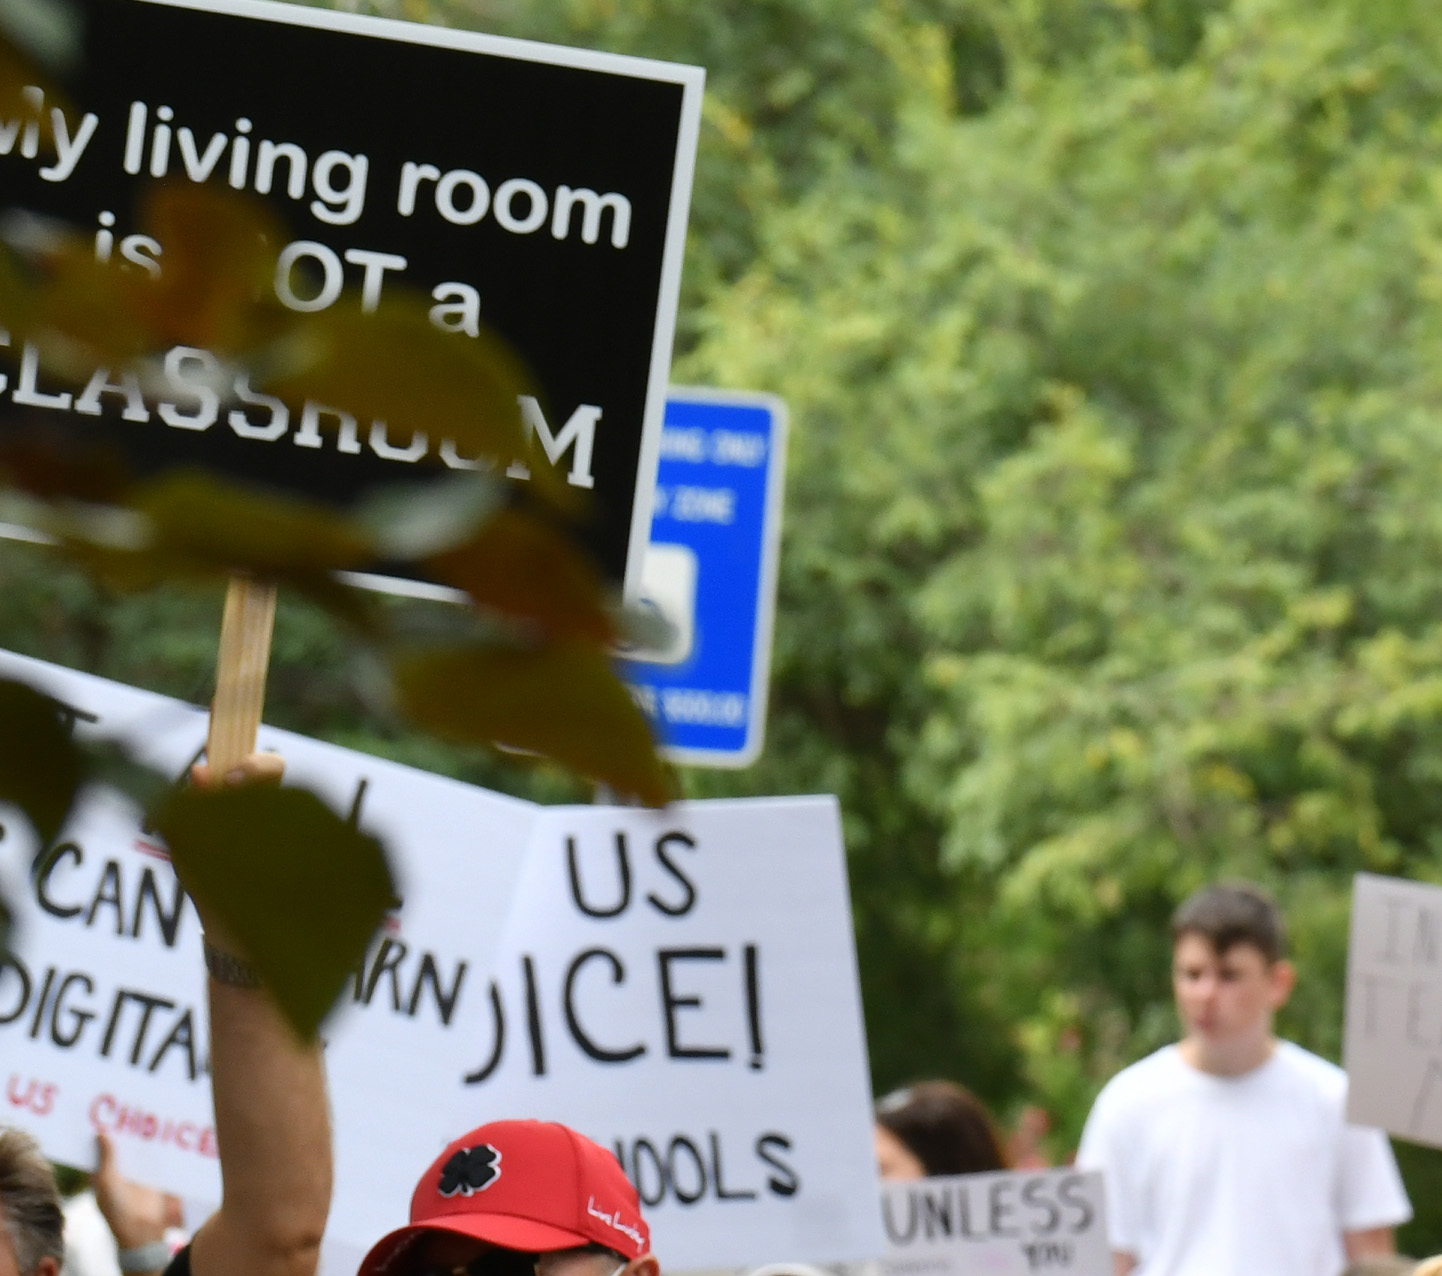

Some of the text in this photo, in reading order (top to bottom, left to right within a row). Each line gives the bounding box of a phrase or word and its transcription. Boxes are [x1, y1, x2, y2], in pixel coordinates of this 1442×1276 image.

[123, 100, 369, 226] living
[399, 161, 633, 250] room
[274, 240, 408, 314] OT
[428, 281, 482, 338] a
[881, 1177, 1096, 1246] UNLESS
